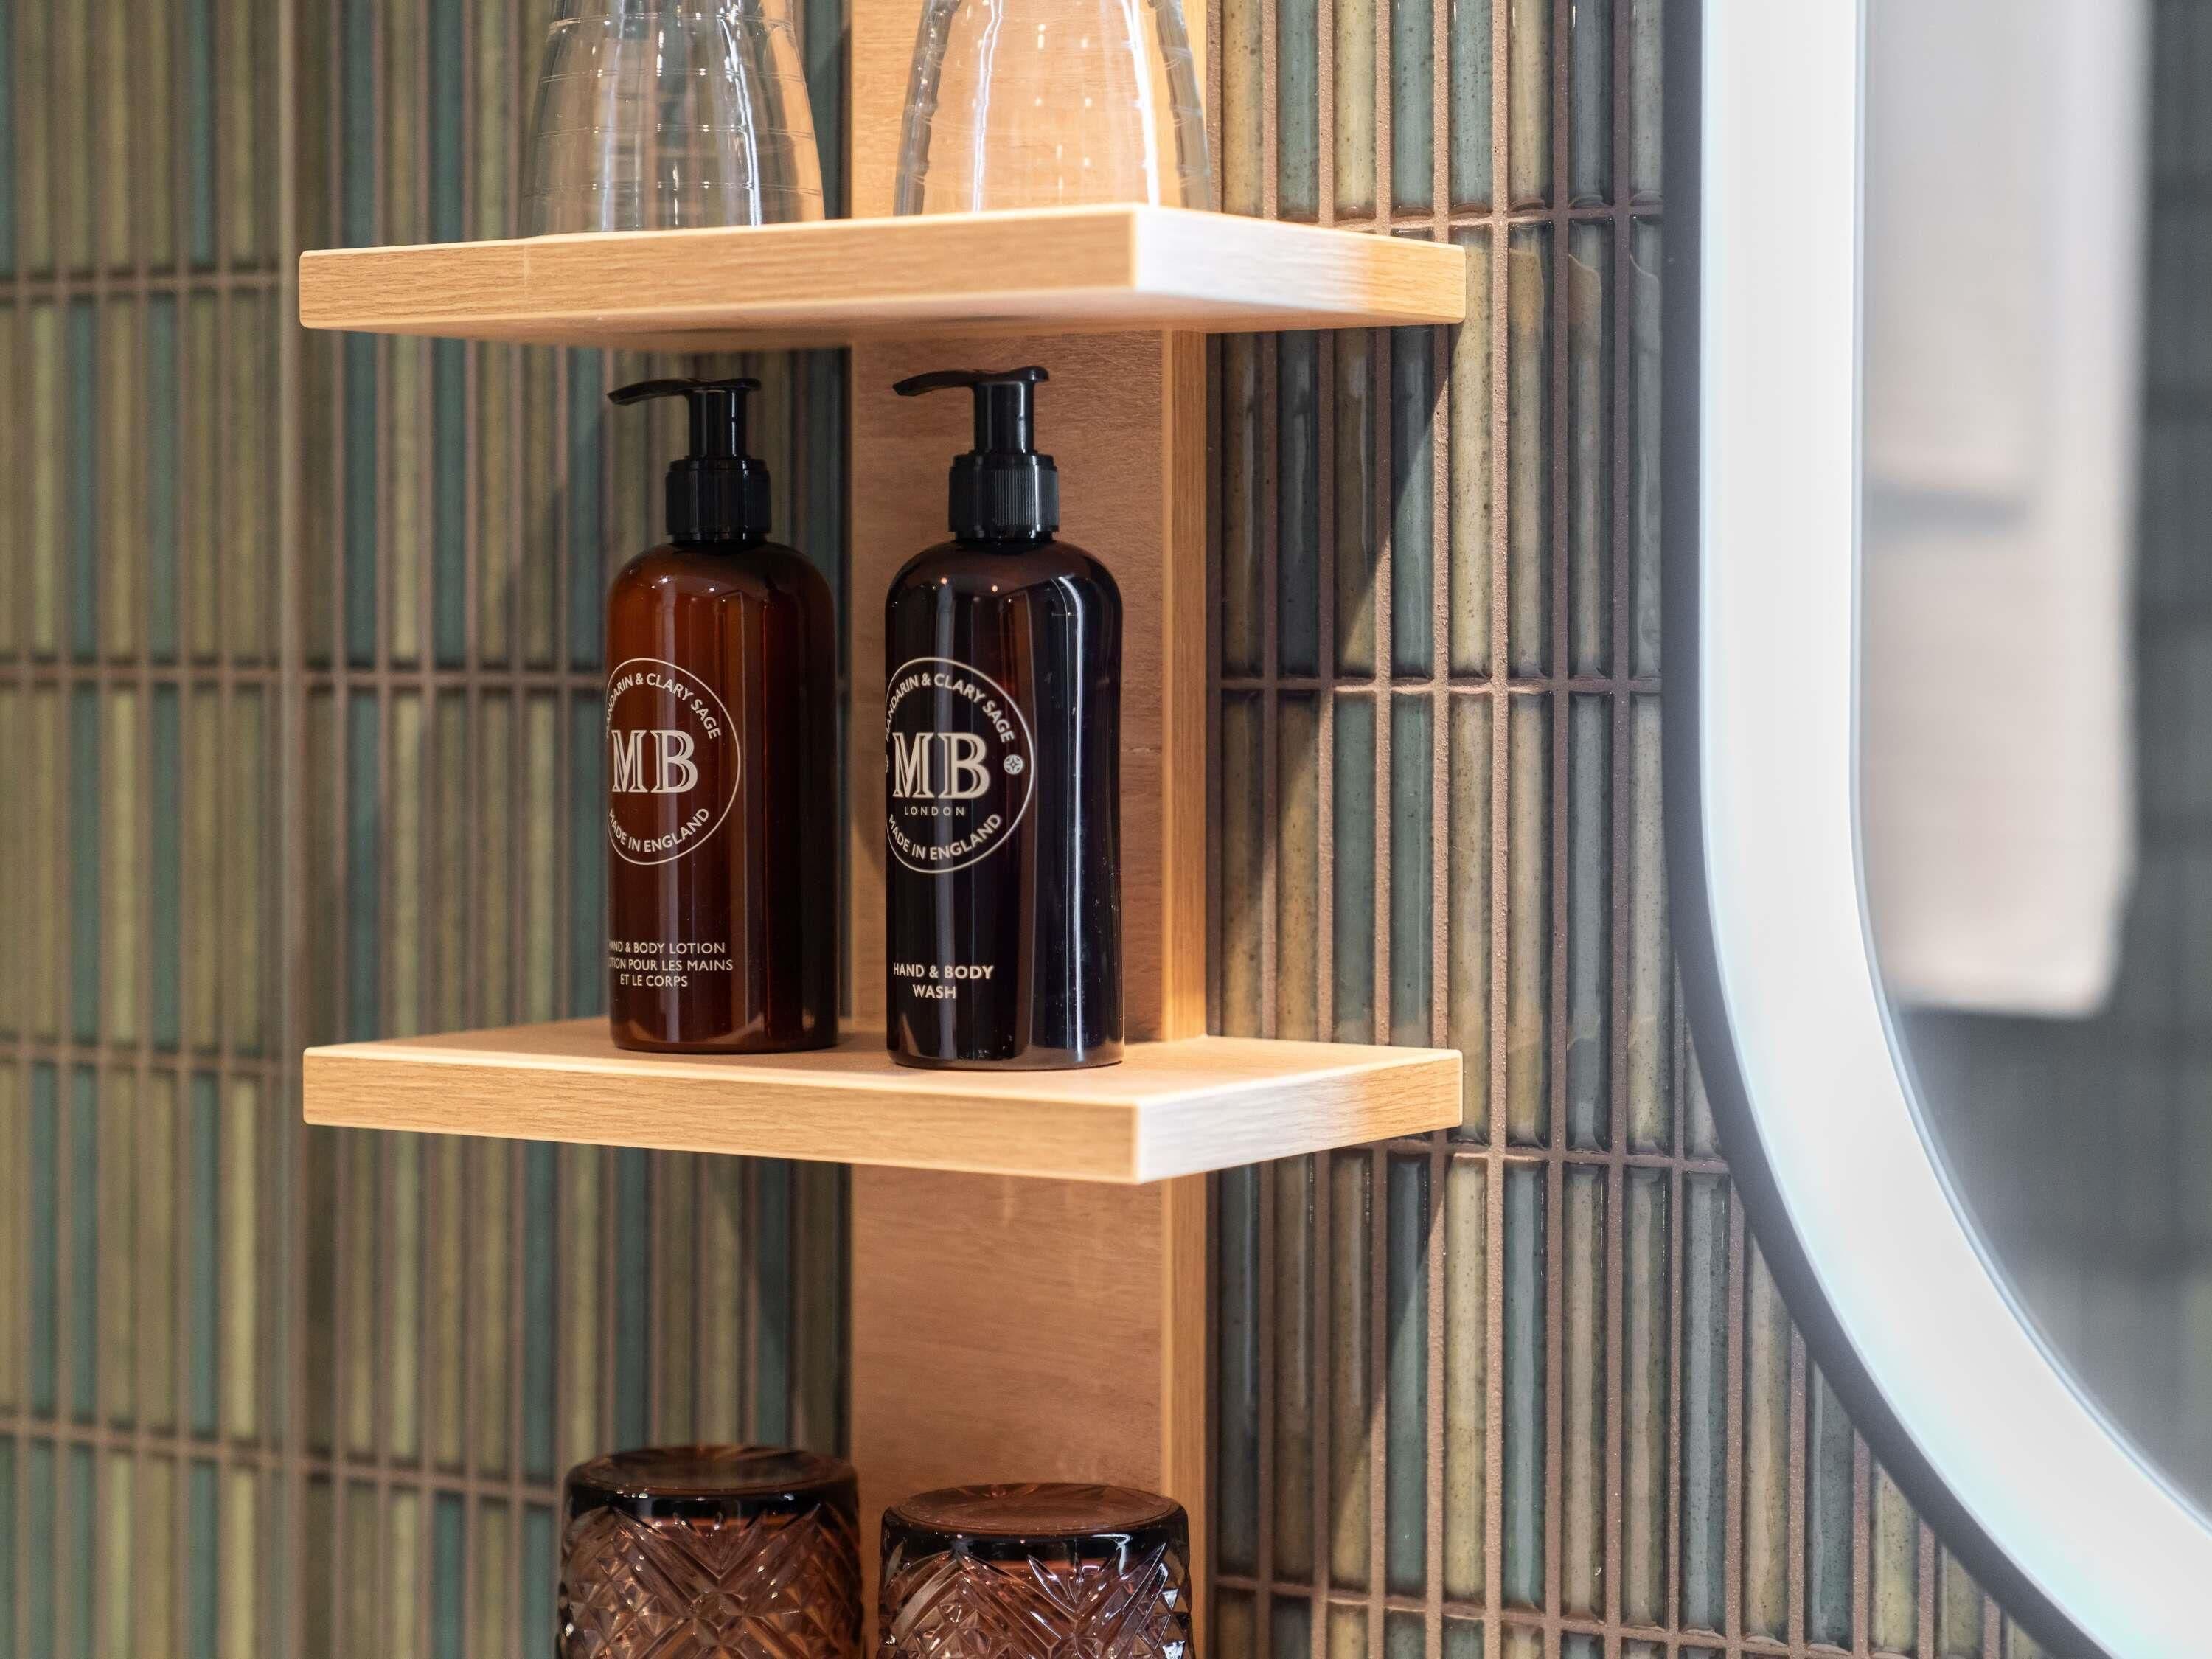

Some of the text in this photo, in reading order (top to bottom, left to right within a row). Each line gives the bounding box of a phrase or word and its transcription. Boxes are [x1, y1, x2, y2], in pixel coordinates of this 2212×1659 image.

[606, 672, 722, 740] NDARIN & CLARY SAGE
[921, 672, 931, 686] &
[934, 673, 986, 703] CLARY
[982, 700, 1015, 743] SAGE
[611, 729, 698, 793] MB
[892, 732, 991, 799] MB
[904, 806, 966, 816] LONDON
[608, 808, 710, 853] MADE IN ENGLAND
[888, 813, 1002, 860] MADE IN ENGLAND
[625, 942, 631, 953] &
[633, 942, 664, 954] BODY
[669, 942, 726, 954] LOTION
[620, 973, 688, 987] ET LE CORPS
[628, 959, 658, 971] POUR
[662, 960, 682, 971] LES
[687, 959, 733, 971] MAINS
[893, 962, 993, 979] HAND & BODY
[912, 984, 956, 998] WASH
